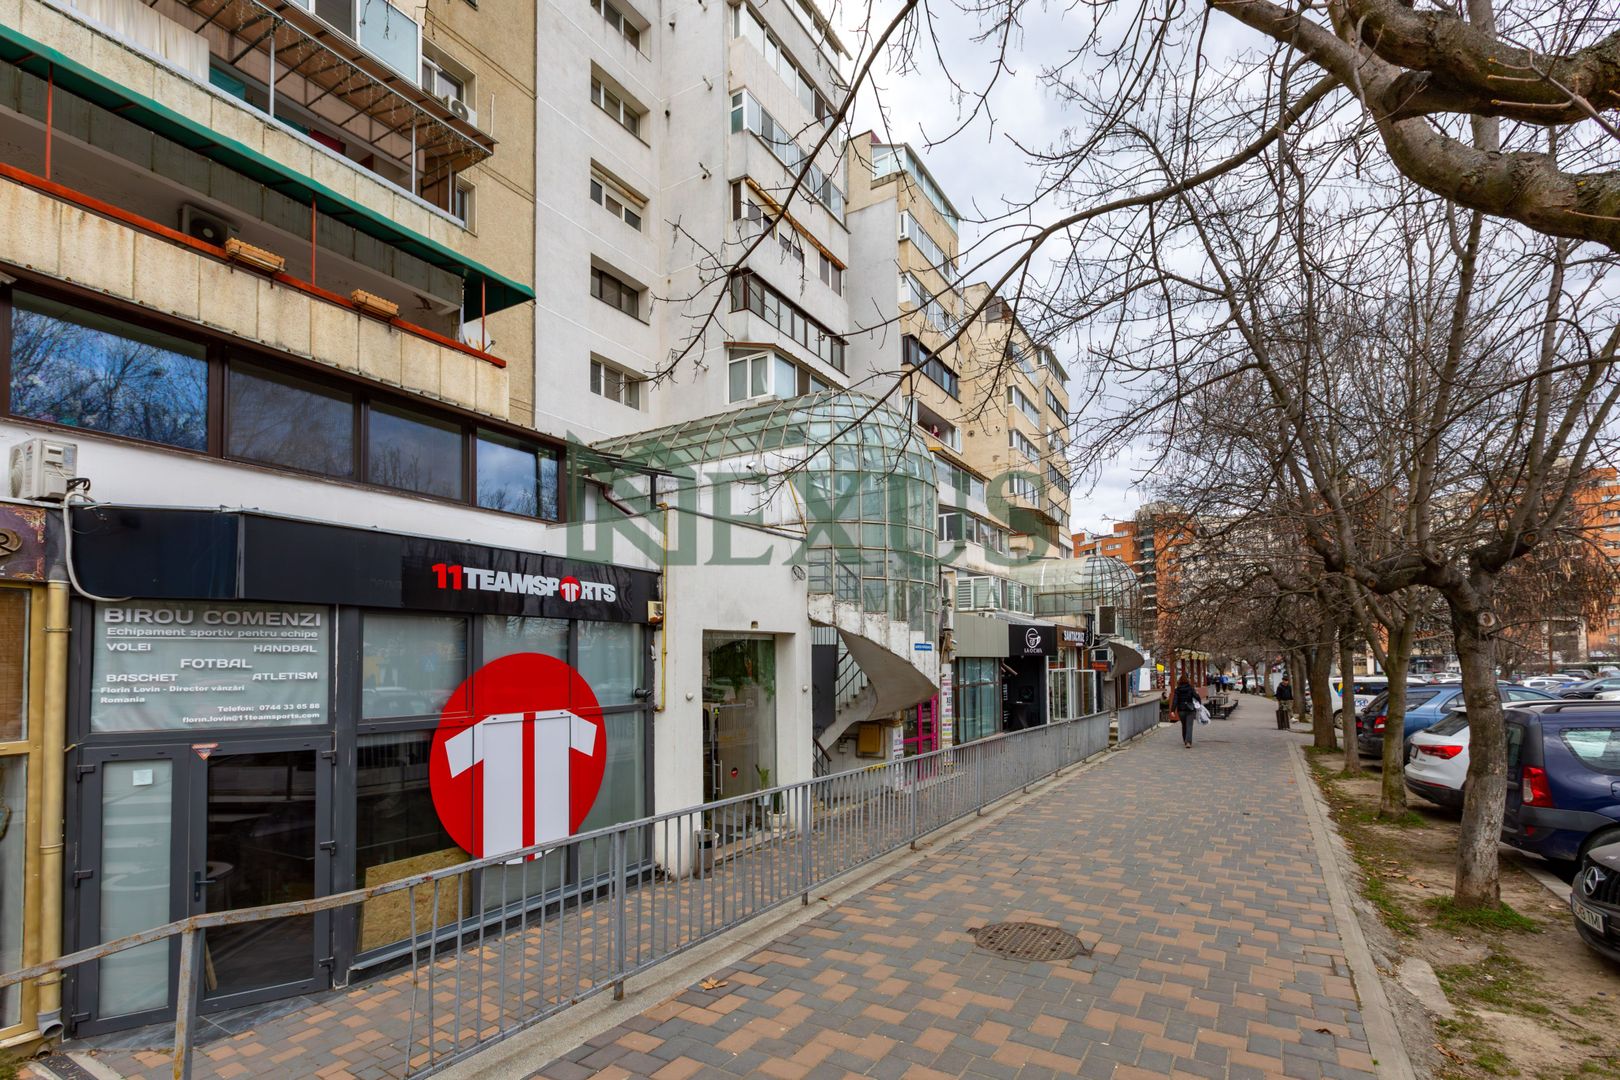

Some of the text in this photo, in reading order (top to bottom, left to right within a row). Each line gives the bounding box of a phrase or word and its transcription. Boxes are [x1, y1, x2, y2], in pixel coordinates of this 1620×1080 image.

[104, 608, 320, 627] BIROU COMENZI
[107, 627, 318, 639] Echipament sportiv pentru echipe
[106, 643, 318, 653] VOLEI HANDBAL
[180, 659, 253, 668] FOTBAL
[106, 672, 318, 682] BASCHET ATLETISM
